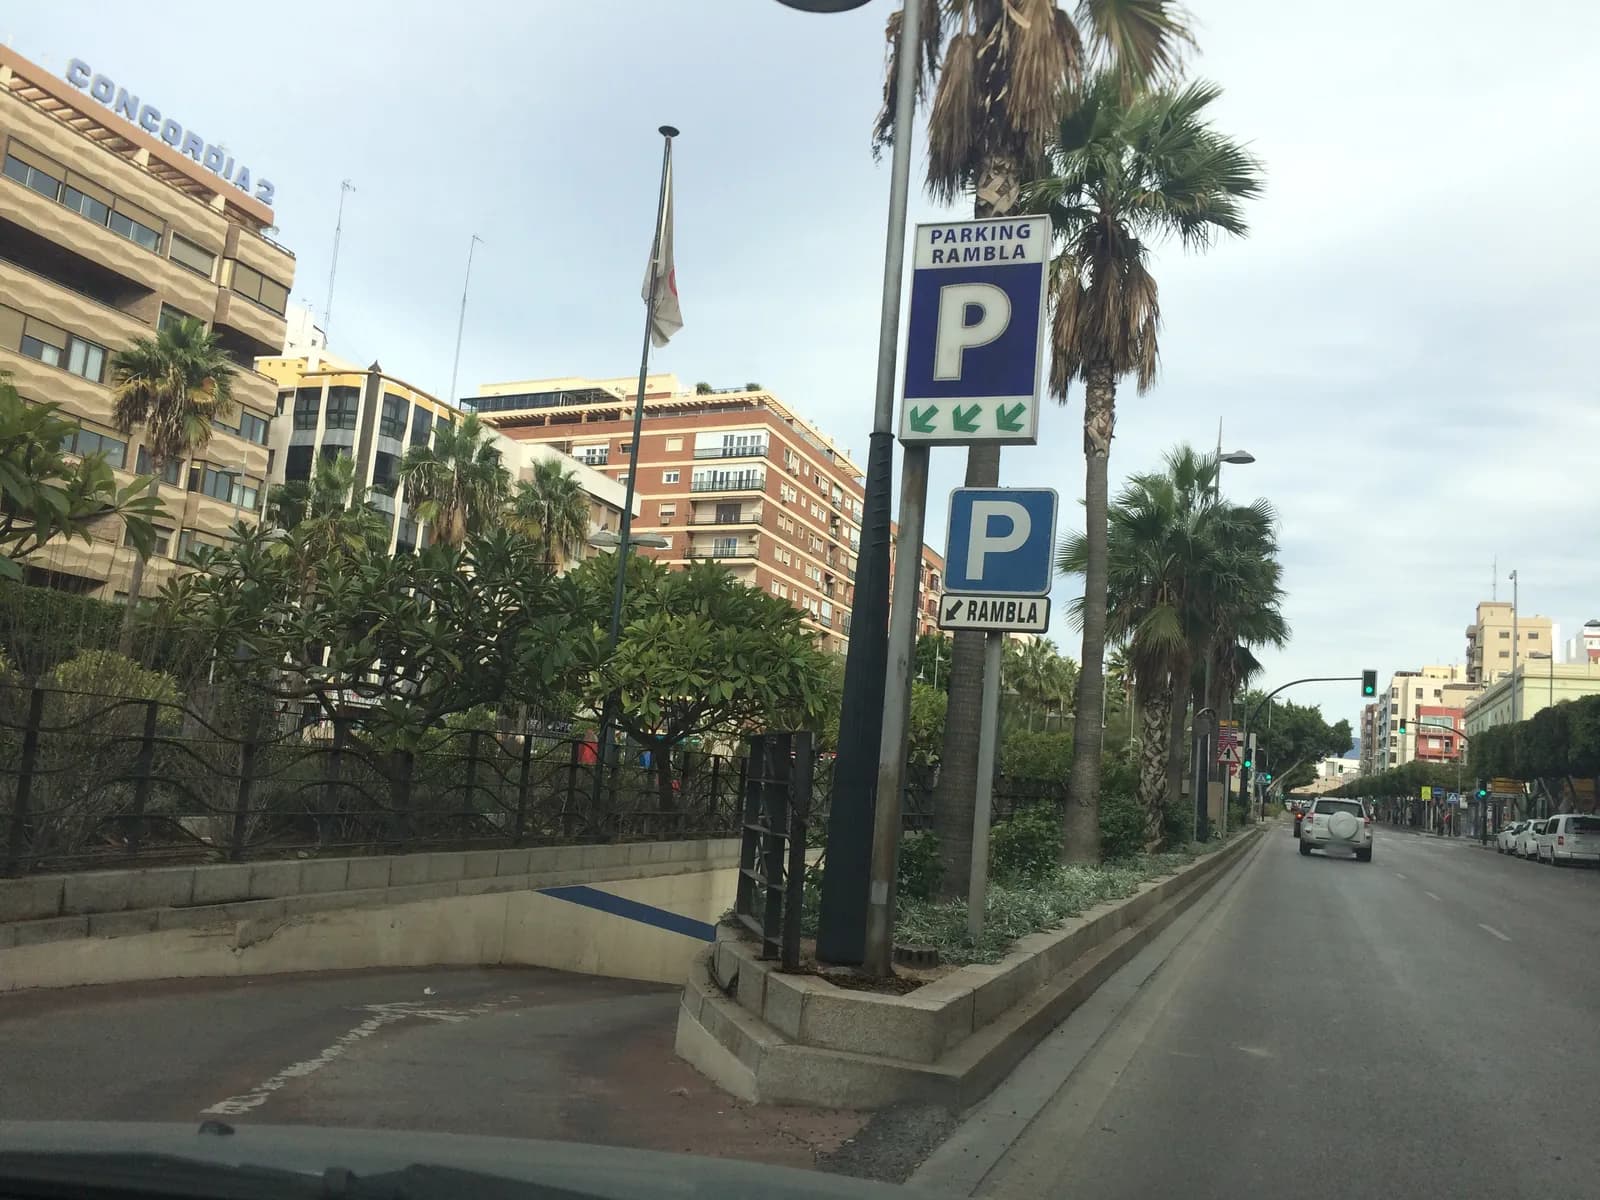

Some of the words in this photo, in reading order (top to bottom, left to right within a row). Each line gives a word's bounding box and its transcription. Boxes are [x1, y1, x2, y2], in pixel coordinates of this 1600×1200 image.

[66, 57, 250, 192] CONCORDIA
[256, 178, 275, 205] 2
[930, 223, 1031, 244] PARKING
[931, 244, 1026, 264] RAMBLA
[933, 283, 1012, 381] P
[966, 501, 1031, 580] P
[967, 600, 1037, 624] RAMBLA
